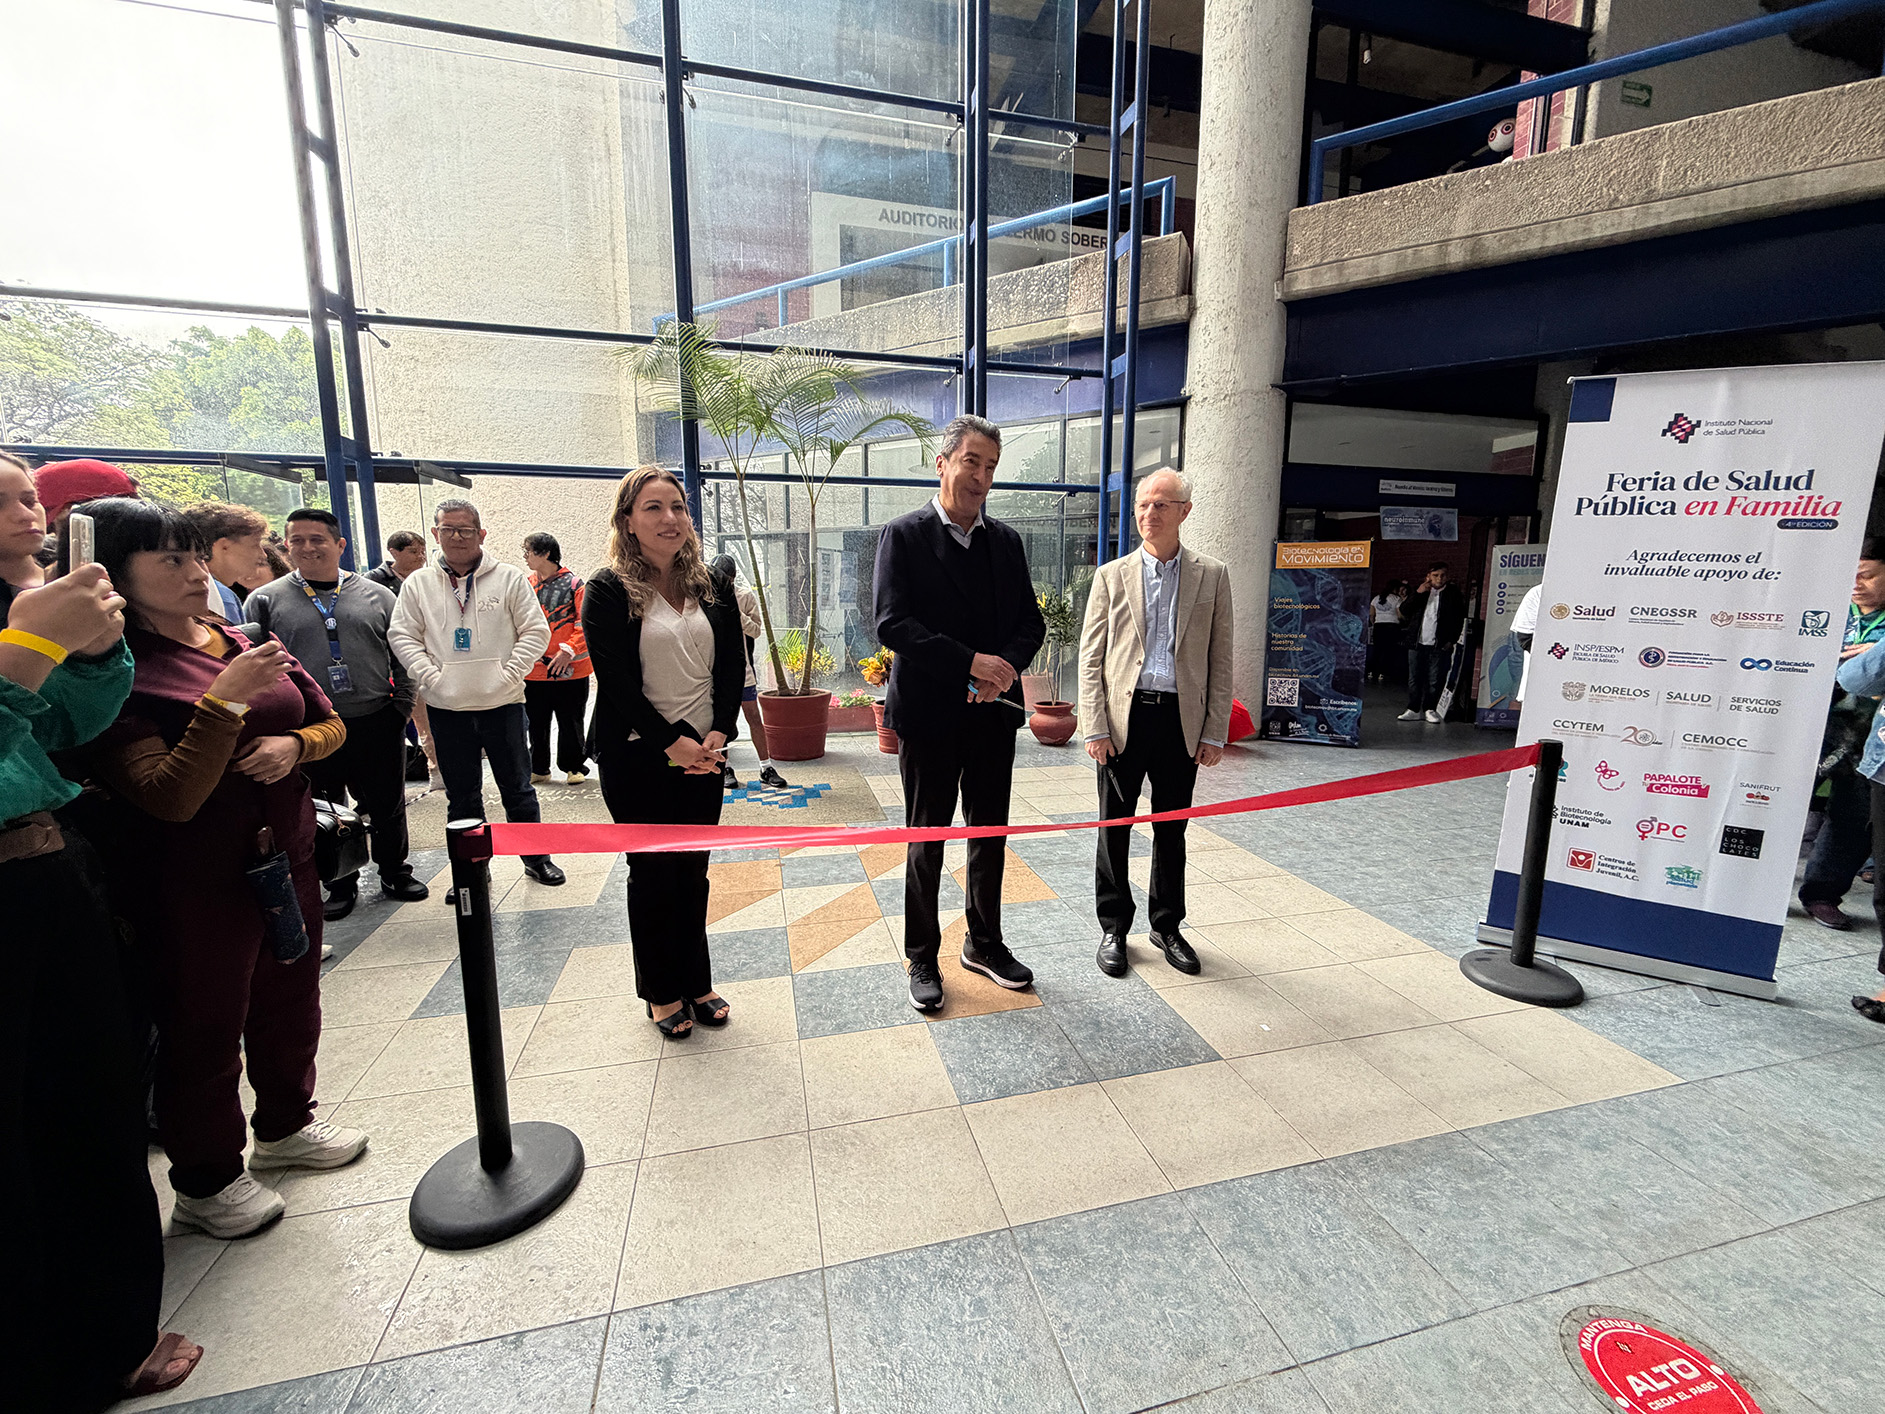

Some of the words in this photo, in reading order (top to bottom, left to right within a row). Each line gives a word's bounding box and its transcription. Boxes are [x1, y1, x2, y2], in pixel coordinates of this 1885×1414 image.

[1738, 418, 1773, 426] Nacional
[1715, 428, 1736, 436] Salud
[1605, 470, 1676, 492] Feria
[1682, 470, 1720, 492] de
[1725, 469, 1815, 491] Salud
[1574, 494, 1677, 516] Pública
[1684, 500, 1717, 516] en
[1723, 495, 1843, 517] Familia
[1626, 549, 1741, 564] Agradecemos
[1745, 551, 1762, 564] el
[1604, 564, 1690, 577] invaluable
[1693, 567, 1748, 582] apoyo
[1752, 568, 1782, 580] de:
[1573, 605, 1616, 617] Salud
[1630, 606, 1697, 619] CNEGSSR
[1736, 612, 1784, 622] ISSSTE
[1798, 628, 1828, 637] IMSS
[1574, 643, 1625, 654] INSP/ESPM
[1775, 660, 1815, 668] Educación
[1589, 684, 1650, 698] MORELOS
[1666, 691, 1712, 703] SALUD
[1730, 696, 1782, 707] SERVICIOS
[1729, 704, 1743, 712] DE
[1745, 706, 1779, 715] SALUD
[1552, 719, 1604, 732] CCYTEM
[1682, 733, 1748, 748] CEMOCC
[1643, 773, 1702, 784] PAPALOTE
[1652, 784, 1699, 795] Colonia
[1740, 782, 1781, 792] SANIFRUT
[1561, 805, 1593, 816] Instituto
[1559, 818, 1590, 828] UNAM
[1560, 811, 1612, 825] Biotecnología
[1598, 854, 1625, 865] Centros
[1597, 861, 1636, 874] Integración
[1581, 1319, 1648, 1351] MANTENGA
[1625, 1357, 1702, 1398] ALTO
[1647, 1395, 1679, 1411] CEDA
[1675, 1391, 1693, 1401] EL
[1688, 1380, 1719, 1396] PASO
